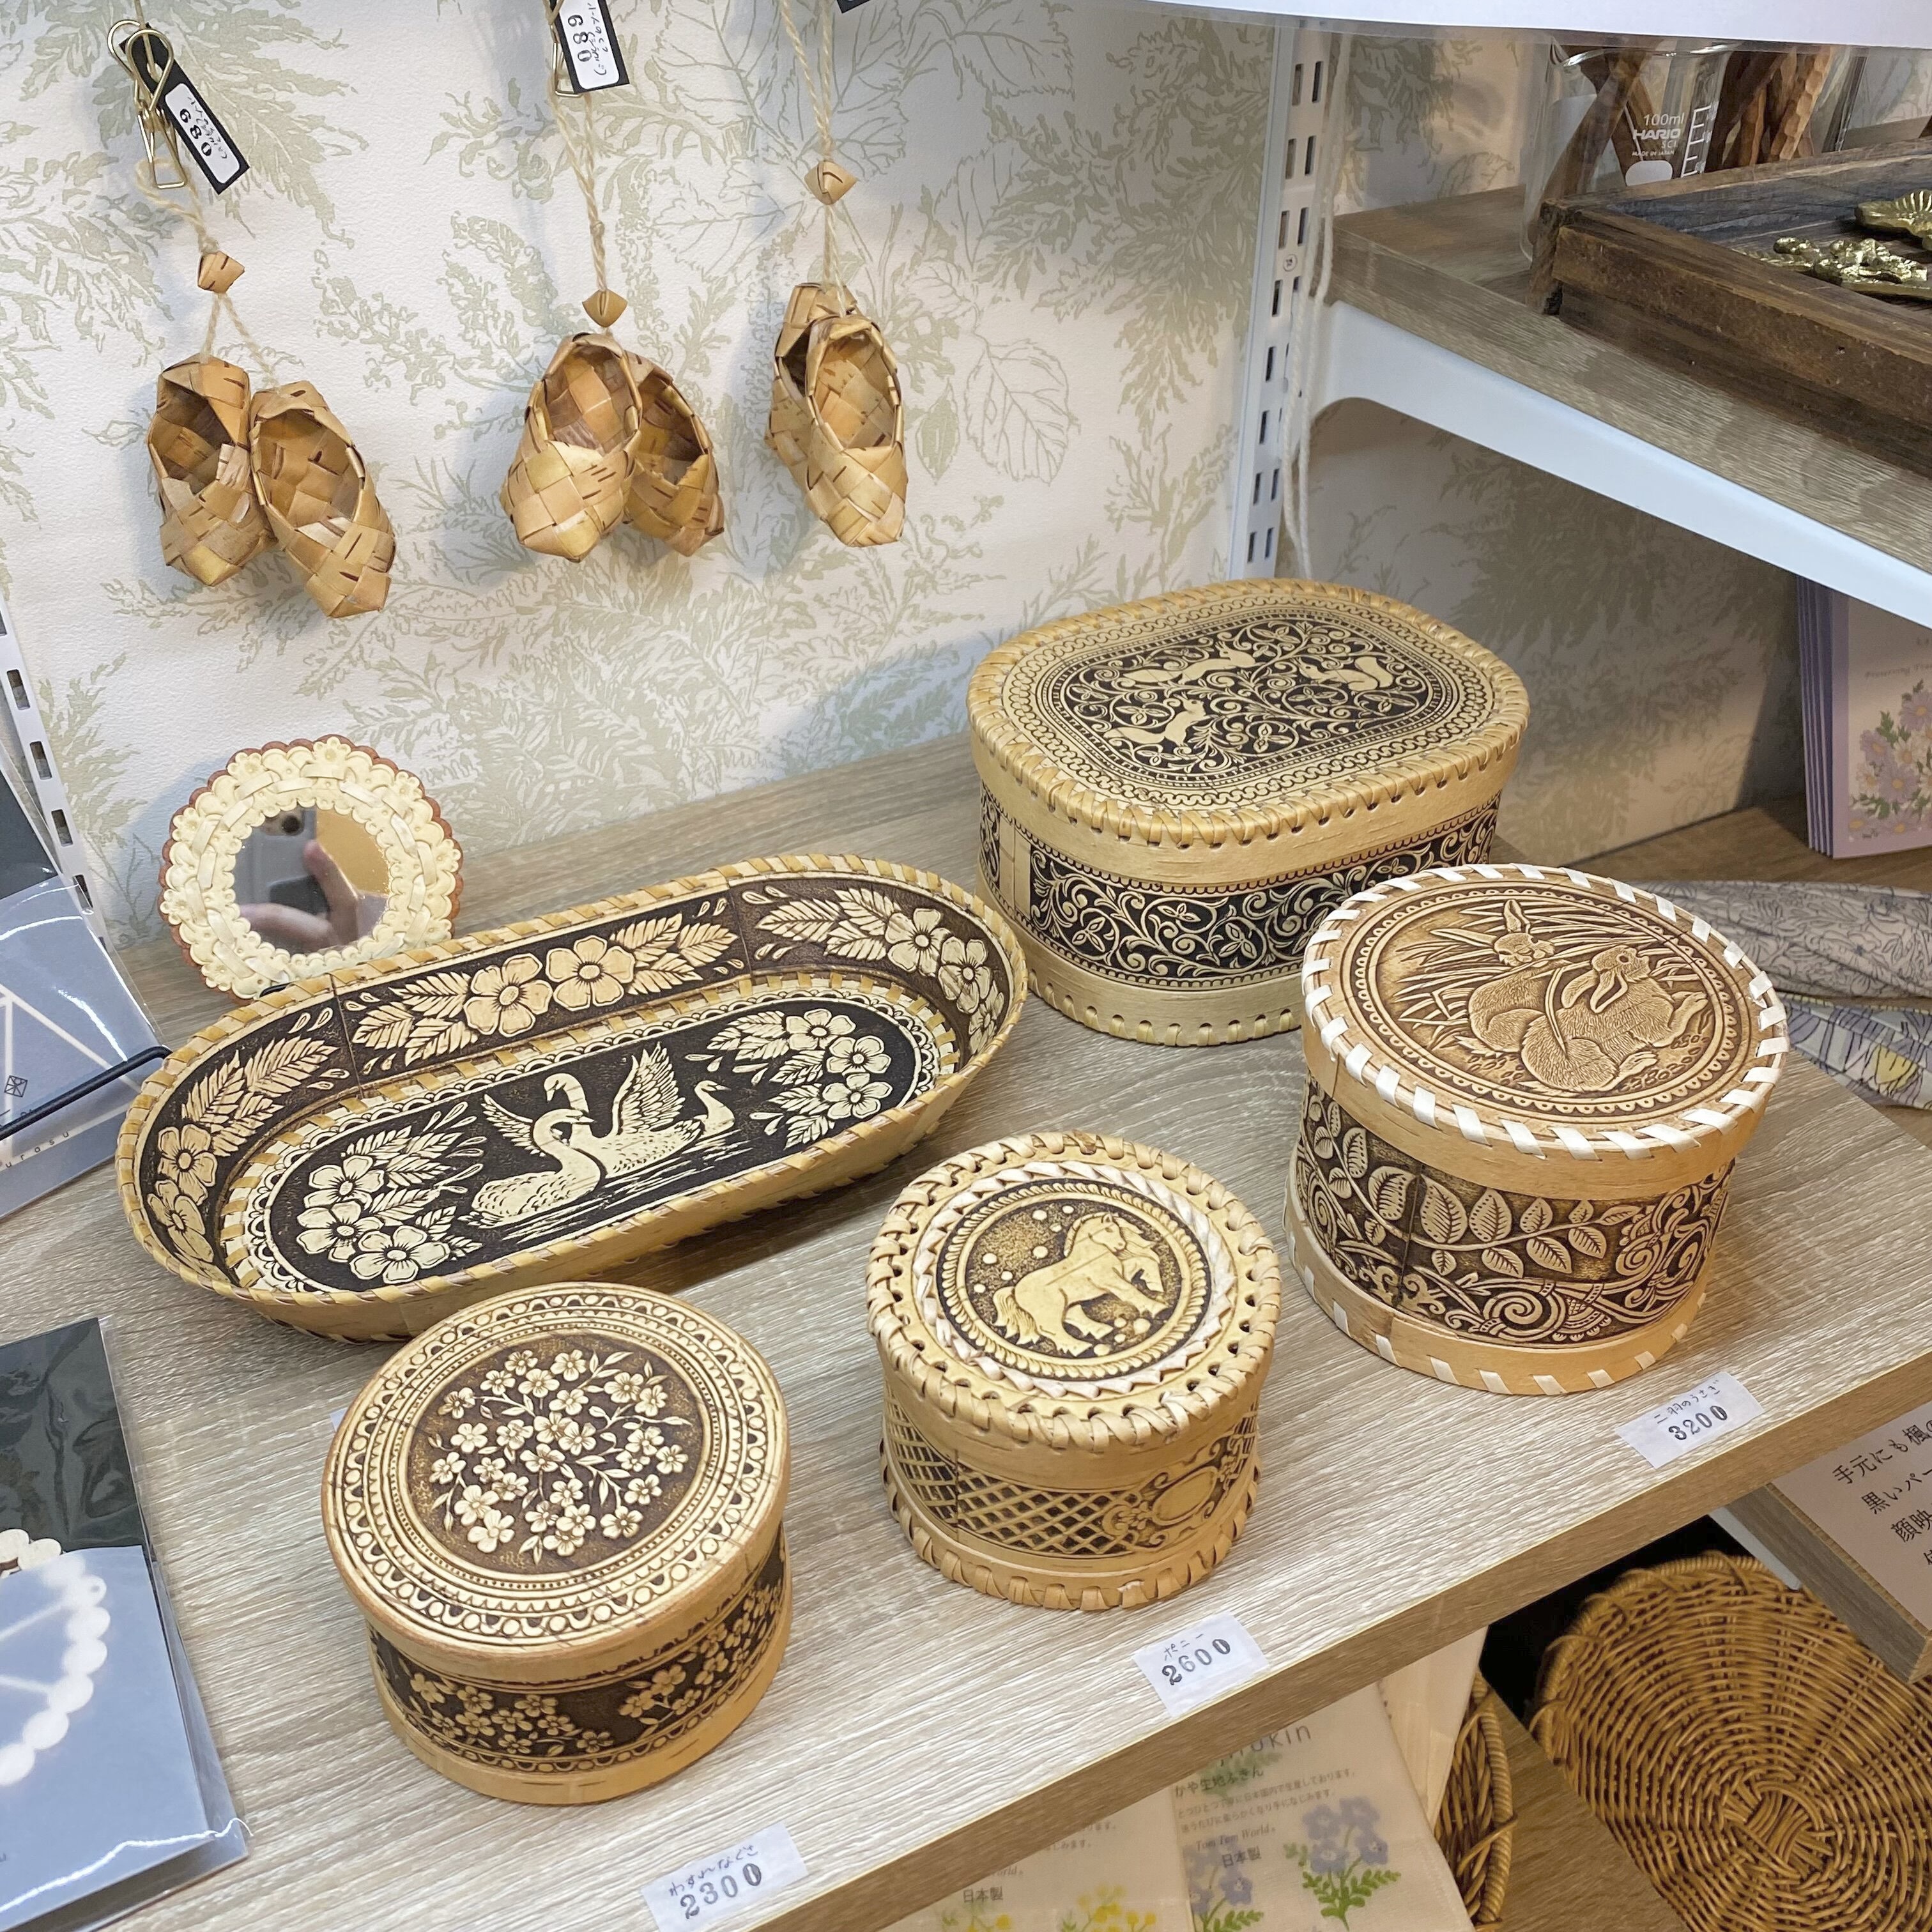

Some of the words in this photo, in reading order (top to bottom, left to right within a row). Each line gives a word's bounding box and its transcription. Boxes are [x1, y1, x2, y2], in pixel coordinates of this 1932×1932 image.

[567, 14, 592, 63] 680
[179, 108, 213, 157] 680
[1632, 128, 1682, 140] HARIO
[1643, 112, 1685, 126] 100ml
[1667, 1405, 1728, 1441] 3200
[1162, 1638, 1231, 1686] 2600
[1164, 1633, 1204, 1662] ポニー
[1221, 1844, 1262, 1869] 日本製
[680, 1862, 762, 1920] 2300
[963, 1885, 1004, 1904] 日本製
